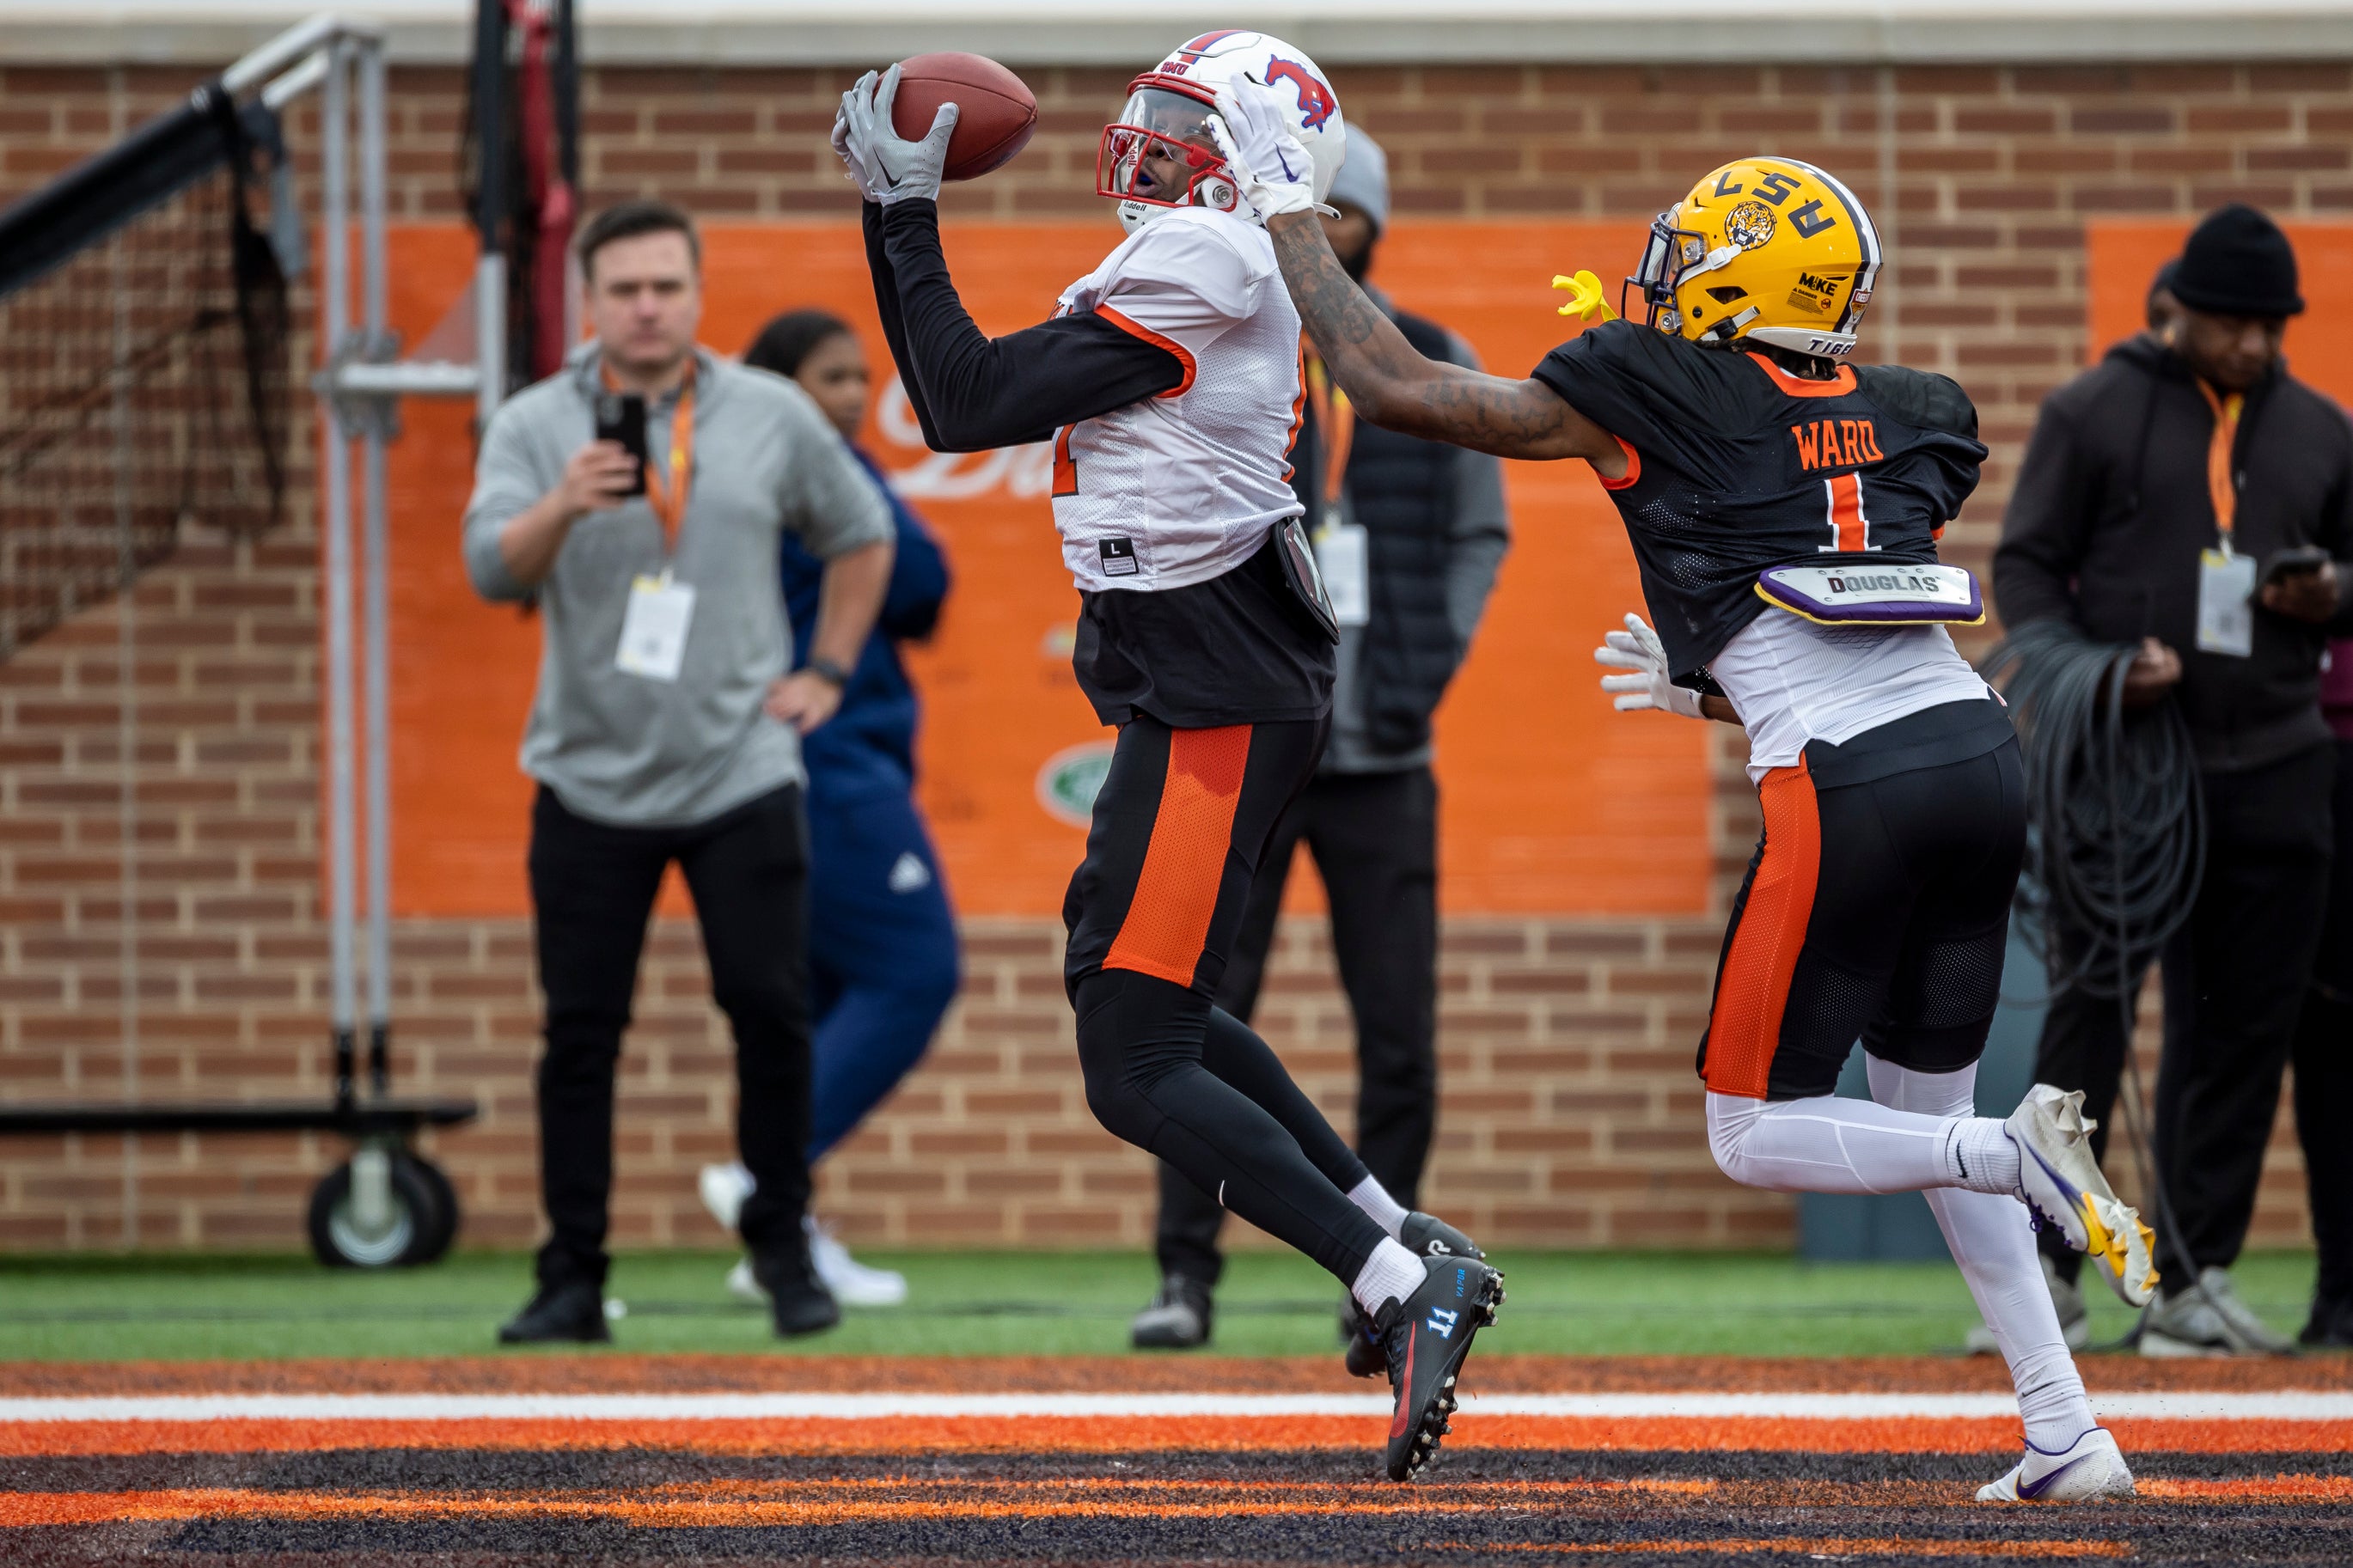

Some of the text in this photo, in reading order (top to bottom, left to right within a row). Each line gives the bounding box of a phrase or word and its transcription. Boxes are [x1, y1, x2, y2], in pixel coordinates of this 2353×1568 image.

[1161, 61, 1189, 76] SMU
[1714, 171, 1837, 239] LSU
[1792, 419, 1884, 470] WARD
[1818, 471, 1882, 552] 1
[1111, 543, 1121, 554] L
[1827, 576, 1940, 594] DOUGLAS
[1456, 1268, 1465, 1297] VAPOR
[1427, 1306, 1459, 1339] 11
